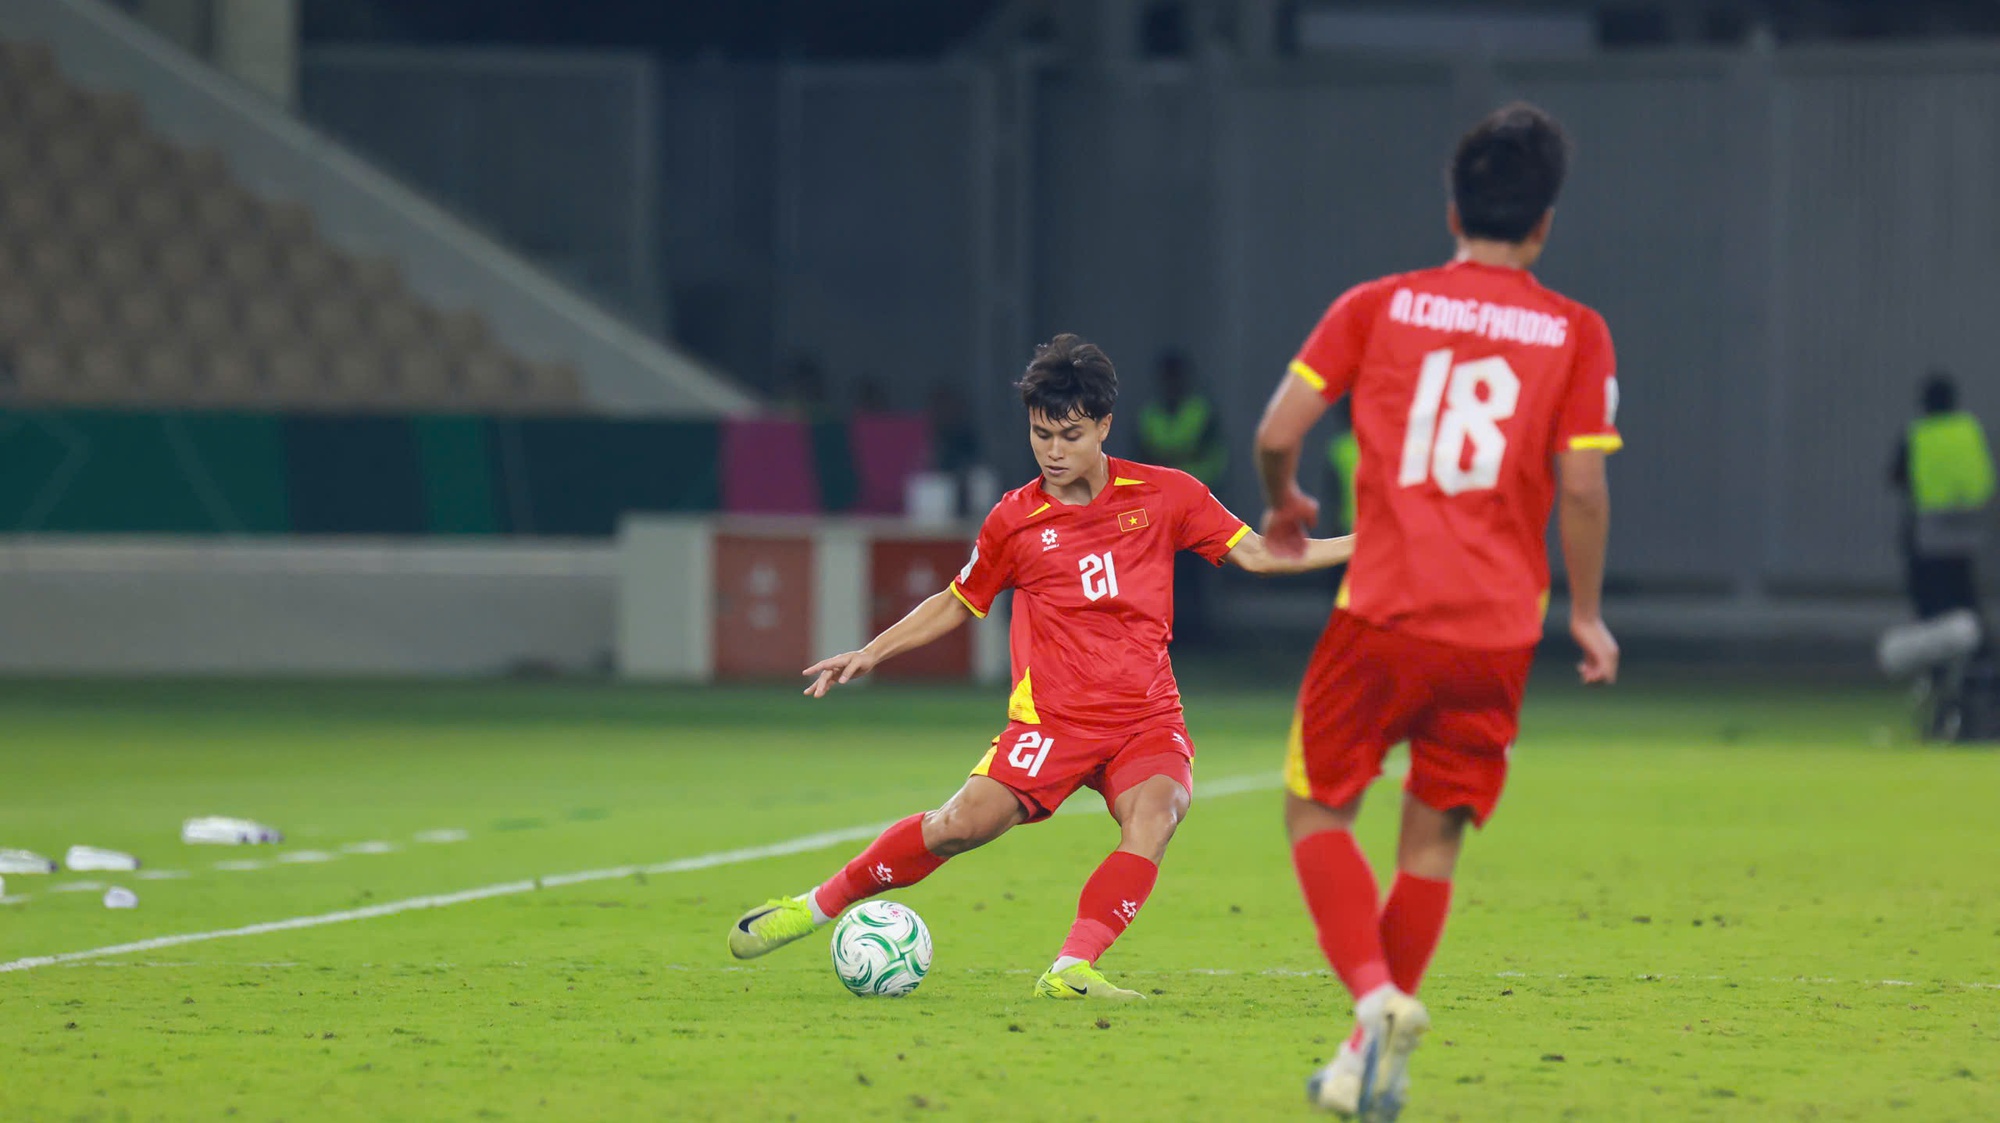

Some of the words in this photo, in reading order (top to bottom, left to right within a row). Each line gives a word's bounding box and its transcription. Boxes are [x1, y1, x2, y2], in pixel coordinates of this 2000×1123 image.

[1399, 348, 1520, 495] 18
[1078, 551, 1119, 602] 21
[1007, 731, 1054, 777] 21
